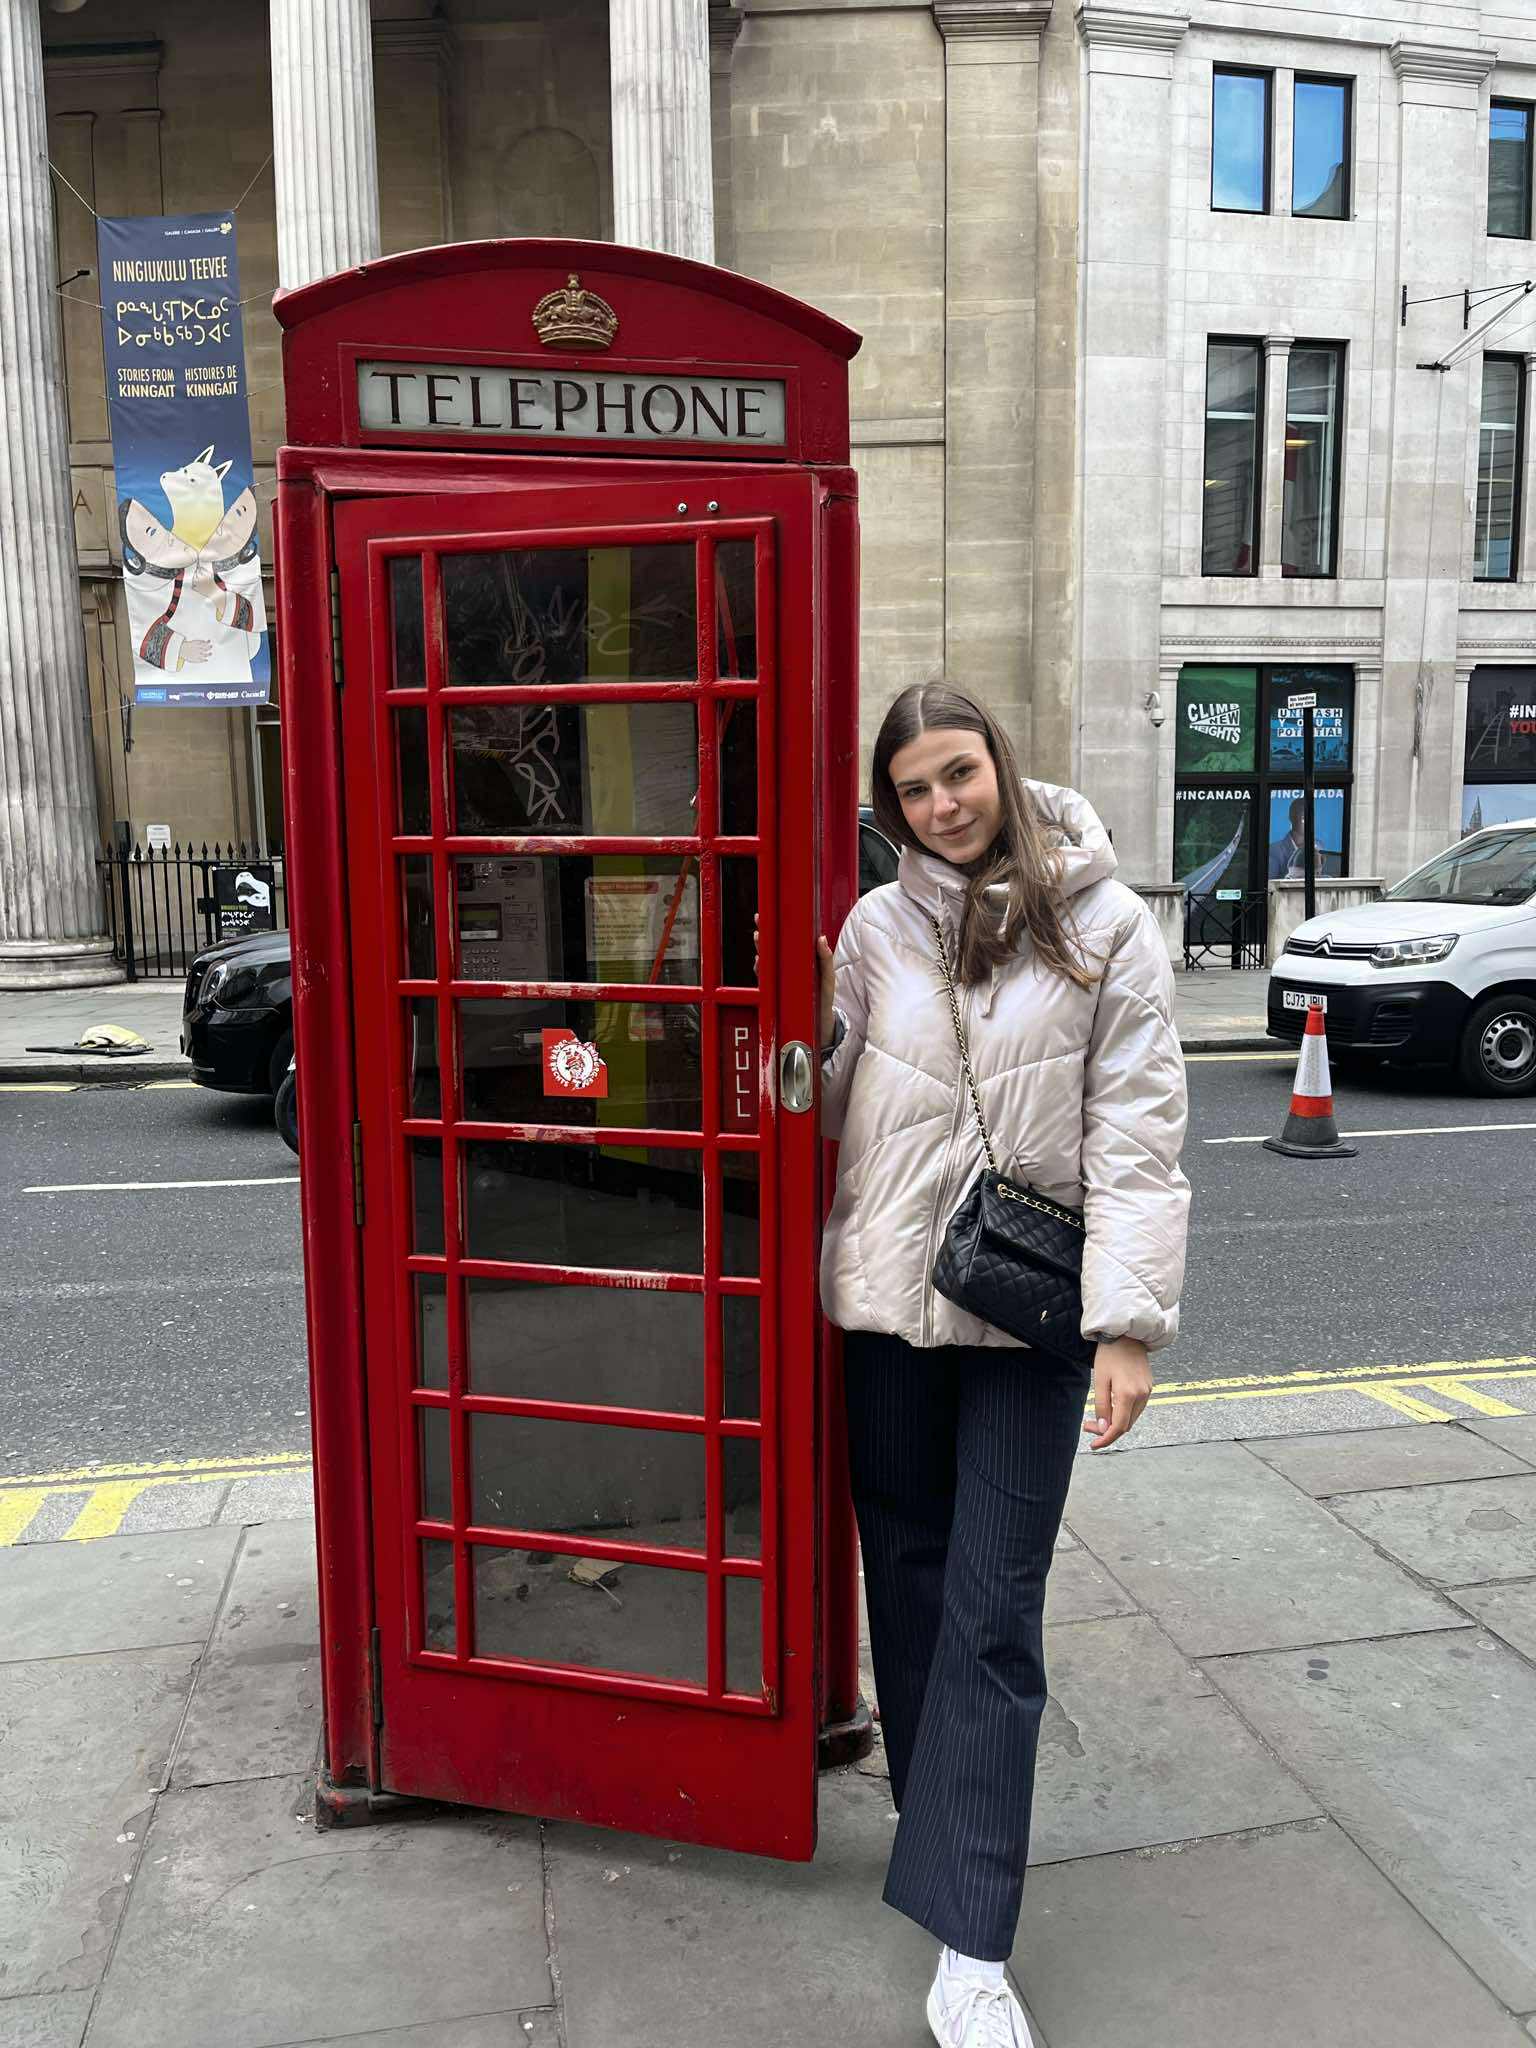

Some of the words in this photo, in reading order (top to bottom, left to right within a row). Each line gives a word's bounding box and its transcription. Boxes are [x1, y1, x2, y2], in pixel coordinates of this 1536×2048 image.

[113, 259, 187, 283] NINGIUKULU
[189, 256, 228, 280] TEEVEE
[117, 368, 150, 382] STORIES
[152, 368, 175, 381] FROM
[185, 366, 224, 381] HISTOIRES
[227, 365, 237, 378] DE
[119, 384, 176, 398] KINNGAIT
[186, 381, 238, 397] KINNGAIT
[370, 371, 767, 439] TELEPHONE
[1188, 703, 1240, 722] CLIMB
[1209, 710, 1239, 725] NEW
[1280, 708, 1341, 718] UNASH
[1279, 728, 1341, 737] POTTIAL
[1176, 789, 1251, 800] #INCANADA
[1286, 992, 1305, 1008] CJ73
[735, 1027, 751, 1117] PULL
